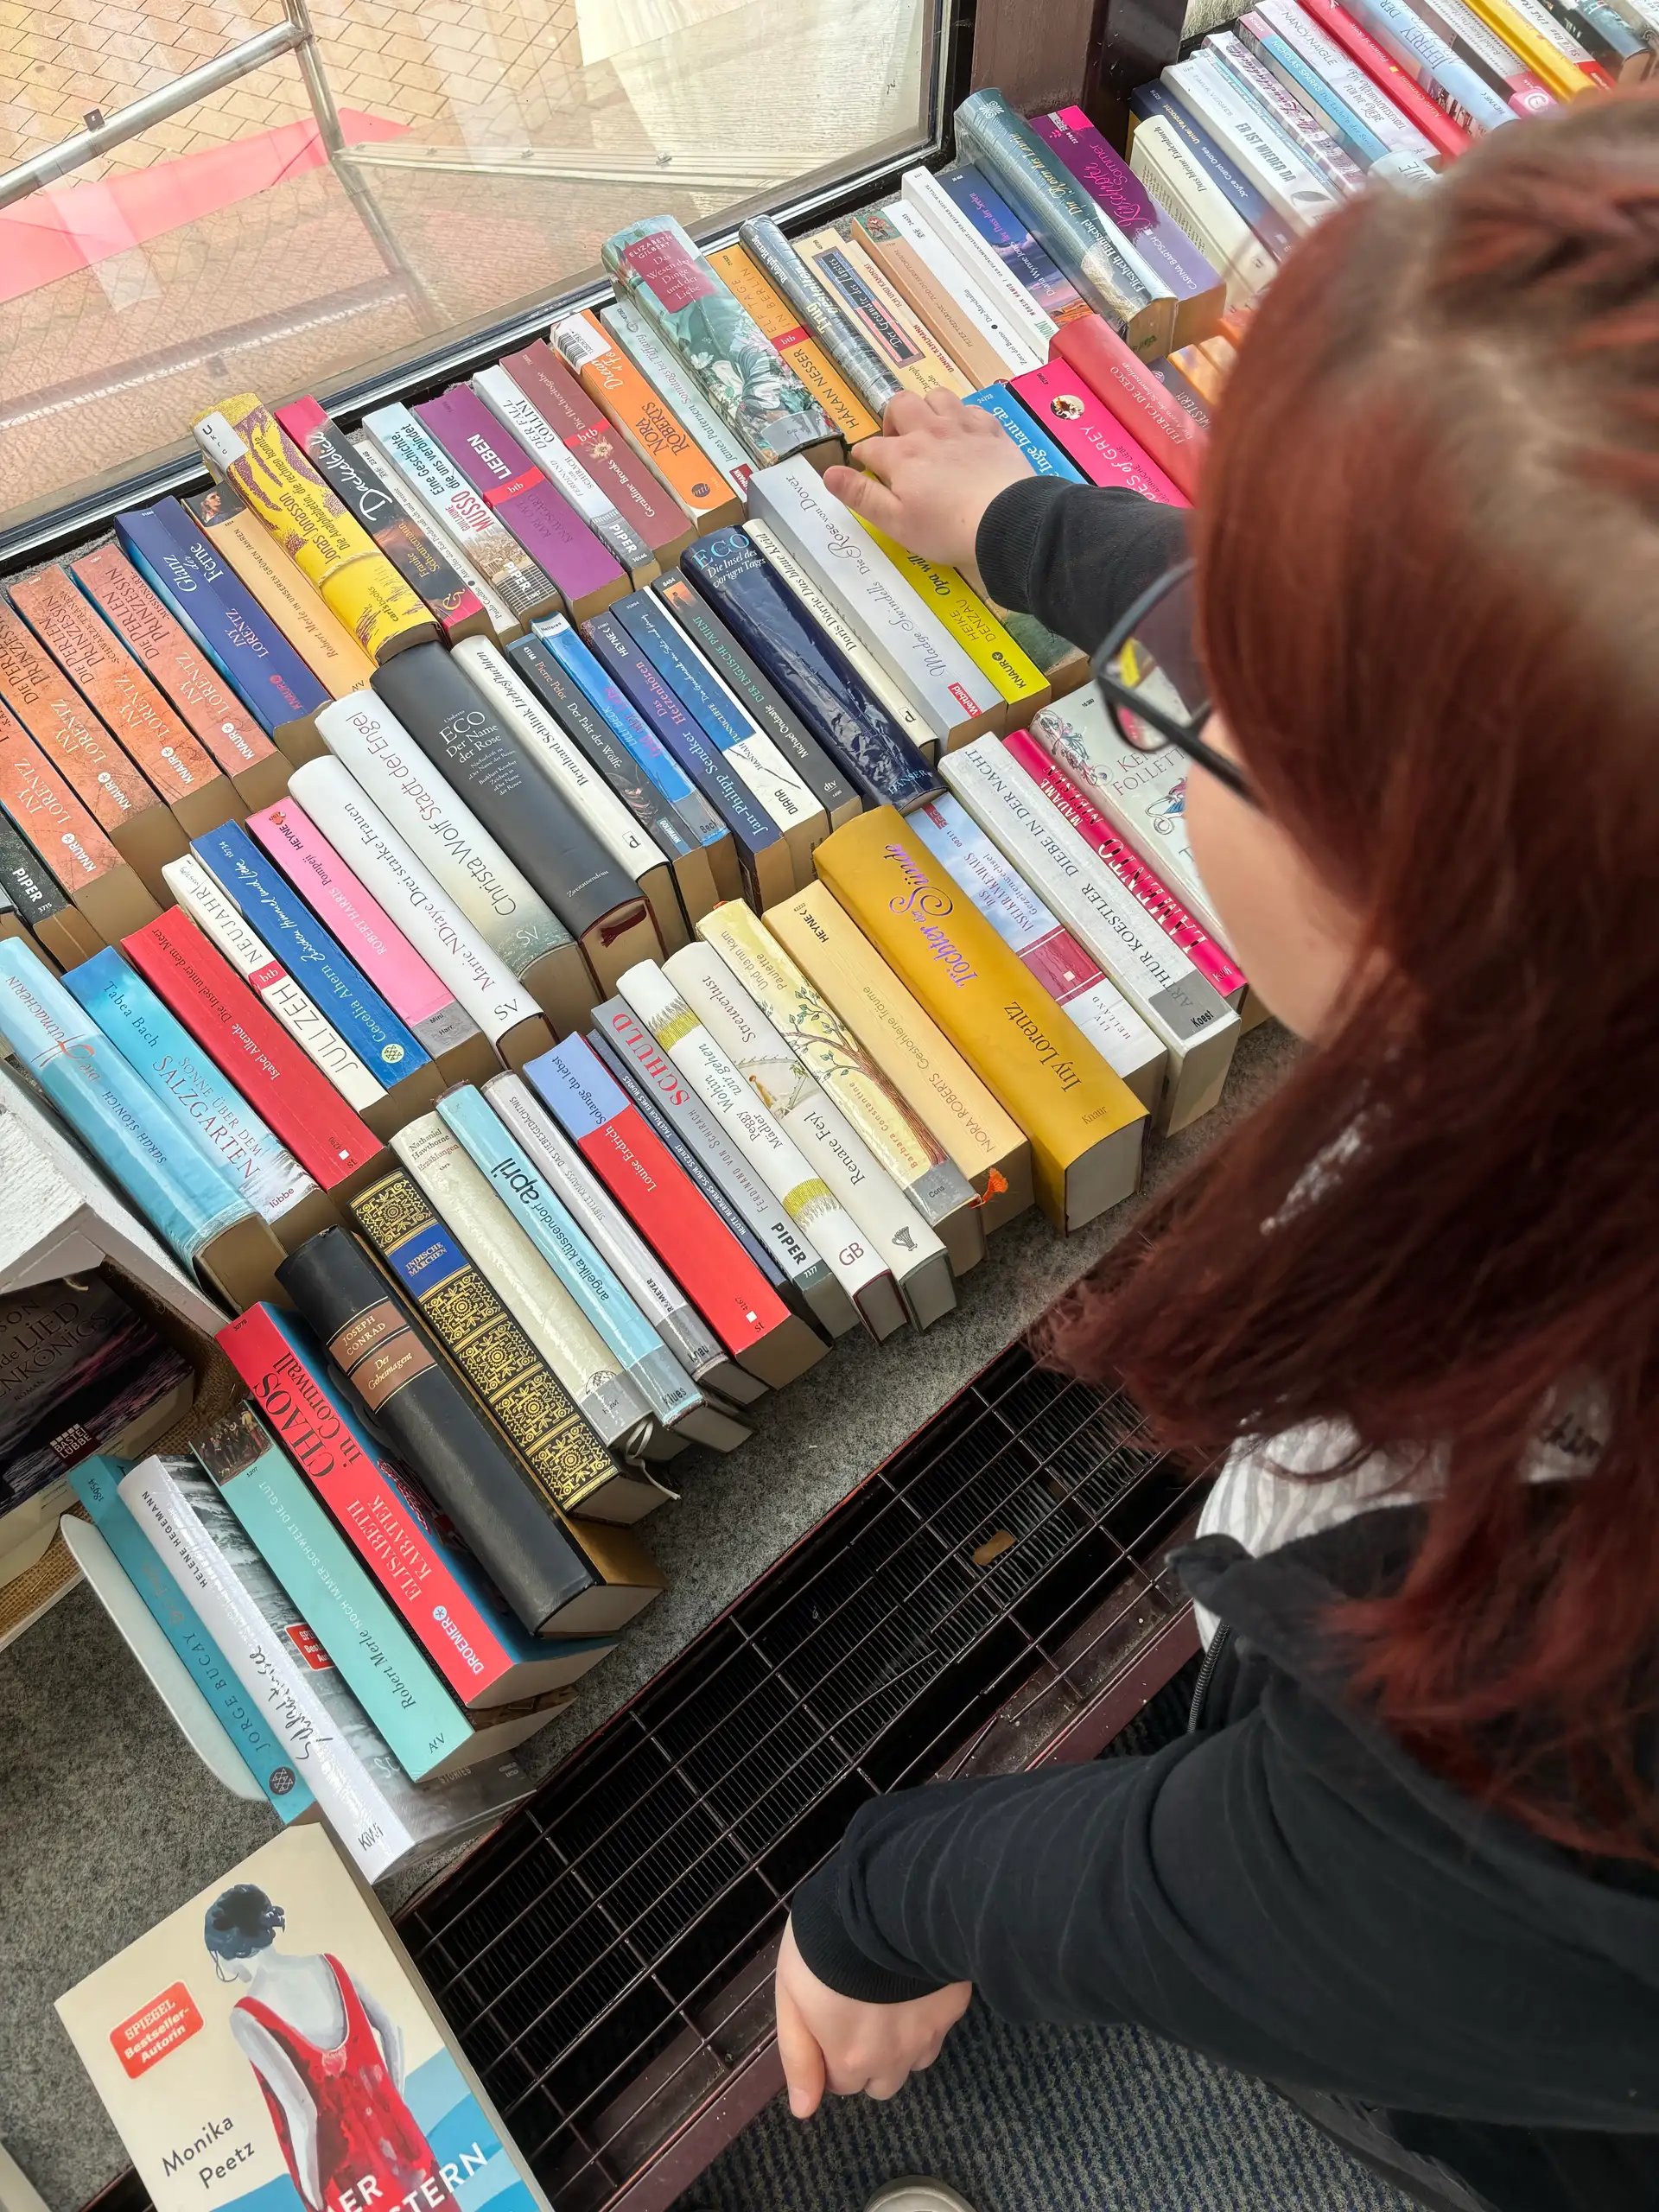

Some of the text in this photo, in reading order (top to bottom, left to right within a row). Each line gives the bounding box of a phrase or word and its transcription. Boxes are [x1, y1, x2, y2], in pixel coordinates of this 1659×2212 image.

[1272, 41, 1323, 92] NICHOLAS SPARKS
[1235, 123, 1297, 183] ER IST WIEDER DA
[629, 234, 673, 258] ELIZABETH
[639, 241, 671, 259] GILBERT
[646, 257, 691, 281] Wesen der
[653, 253, 671, 265] Das
[1151, 235, 1197, 290] CARINA BARTSCH
[661, 268, 689, 284] Dinge
[667, 276, 698, 296] und der
[676, 284, 702, 300] Liebe
[780, 334, 796, 346] btb
[793, 348, 860, 430] HÅKAN NESSER
[1109, 366, 1185, 446] FEDERICA DE CESCO
[505, 399, 548, 449] DER FALL
[518, 399, 555, 443] COLLINI
[635, 417, 664, 456] NORA
[641, 402, 690, 456] ROBERTS
[993, 406, 1052, 475] Inge haut ab
[391, 429, 445, 496] Eine Geschichte,
[400, 423, 461, 492] die uns verbindet
[467, 434, 512, 480] LIEBEN
[1081, 426, 1134, 474] of GREY
[450, 491, 495, 532] MUSSO
[507, 483, 524, 493] btb
[607, 460, 655, 518] Geraldine Brooks
[279, 493, 341, 566] Jonas Jonasson
[609, 524, 637, 553] PIPER
[692, 534, 750, 570] ECO
[707, 550, 757, 579] Die Insel des
[713, 557, 766, 588] vorigen Tages
[755, 534, 857, 652] Doris Dörrie Das blaue Kleid
[225, 608, 269, 658] LORENTZ
[226, 626, 246, 647] INY
[950, 610, 979, 641] HEIKE
[957, 600, 997, 643] DENZAU
[693, 616, 765, 702] DER ENGLISCHE PATIENT
[997, 659, 1027, 687] KNAUR
[175, 652, 231, 715] LORENTZ
[177, 680, 204, 705] INY
[951, 685, 979, 715] Weltbild
[229, 729, 255, 760] KNAUR
[439, 711, 486, 746] ECO
[446, 724, 499, 759] Der Name
[458, 735, 503, 764] der Rose
[522, 707, 590, 786] Bernhard Schlink
[765, 705, 810, 759] Michael Ondaatje
[682, 733, 768, 836] Jan-Philipp Sendker
[346, 712, 517, 917] Christa Wolf Stadt der Engel
[963, 749, 1080, 878] DIEBE IN DER NACHT
[11, 868, 43, 903] PIPER
[344, 802, 497, 993] Marie NDiaye Drei starke Frauen
[329, 885, 388, 956] ROBERT HARRIS
[1082, 882, 1141, 948] KOESTLER
[259, 969, 279, 982] btb
[104, 981, 158, 1047] Tabea Bach
[321, 965, 386, 1042] Cecelia Ahern
[701, 976, 756, 1045] Streuverlust
[232, 1023, 282, 1082] Isabel Allende
[271, 984, 359, 1073] JULI ZEH
[1003, 1000, 1082, 1095] Iny Lorentz
[612, 1012, 690, 1107] SCHULD
[153, 1055, 261, 1180] SALZGARTEN
[735, 1110, 762, 1143] Peggy
[753, 1113, 784, 1150] Mädler
[604, 1126, 657, 1192] Louise Erdrich
[803, 1111, 866, 1186] Renate Feyl
[269, 1187, 295, 1209] lübbe
[496, 1156, 541, 1205] april
[404, 1241, 444, 1270] INDISCHE
[408, 1247, 448, 1277] MÄRCHEN
[531, 1197, 609, 1301] angelika klüssendorf
[771, 1222, 808, 1265] PIPER
[342, 1315, 376, 1345] JOSEPH
[346, 1321, 387, 1356] CONRAD
[368, 1351, 414, 1390] Geheimagent
[374, 1354, 391, 1370] Der
[254, 1374, 335, 1478] CHAOS
[273, 1351, 364, 1467] in Cornwall
[54, 1426, 86, 1454] BASTEI
[59, 1434, 92, 1460] LÜBBE
[247, 1466, 258, 1478] 1207
[142, 1490, 209, 1588] HELENE HEGEMANN
[345, 1499, 422, 1601] ELISABETH
[373, 1496, 433, 1581] KABATEK
[359, 1630, 416, 1709] Robert Merle
[445, 1620, 485, 1675] DROEMER
[182, 1632, 271, 1751] JORGE BUCAY
[124, 1998, 176, 2040] SPIEGEL
[124, 2006, 191, 2060] Bestseller-
[140, 2024, 187, 2063] Autorin
[161, 2114, 235, 2177] Monika
[197, 2141, 257, 2189] Peetz
